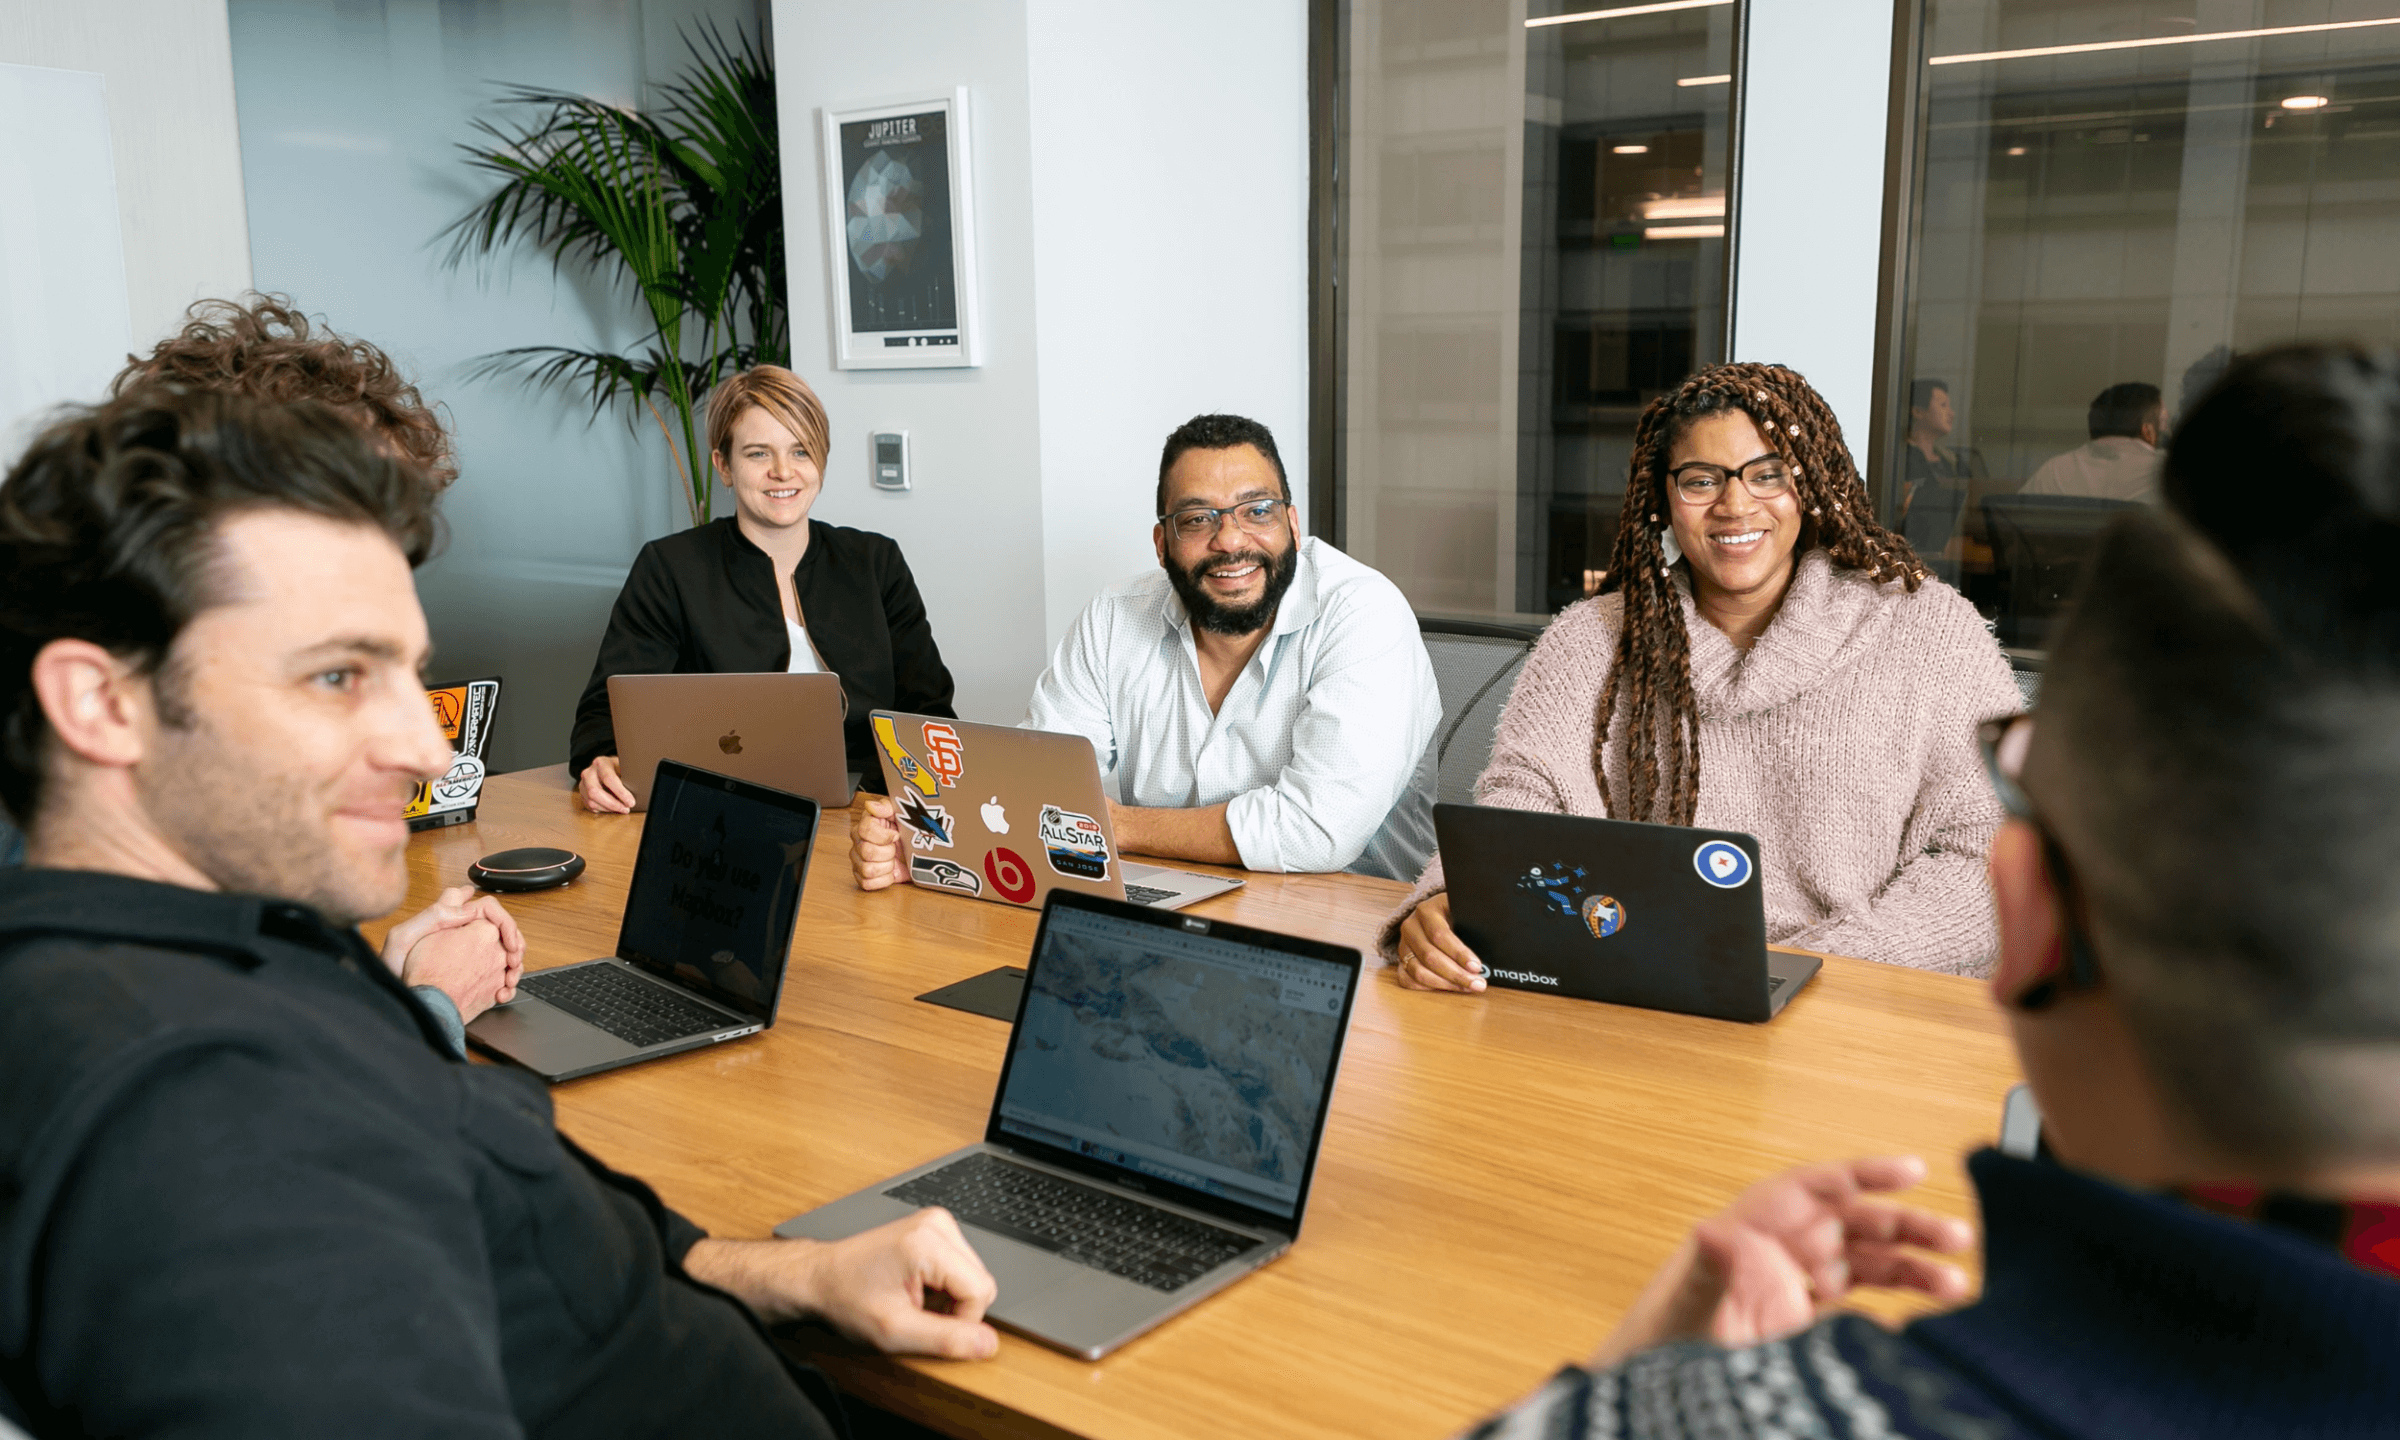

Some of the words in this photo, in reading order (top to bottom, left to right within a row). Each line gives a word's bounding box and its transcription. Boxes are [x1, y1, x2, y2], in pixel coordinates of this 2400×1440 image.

[868, 118, 916, 139] JUPITER
[670, 841, 693, 869] Do
[731, 866, 761, 892] use
[1056, 859, 1074, 867] SAN
[1077, 863, 1099, 872] JOSE
[670, 883, 745, 930] Mapbox?
[1493, 968, 1559, 986] mapbox
